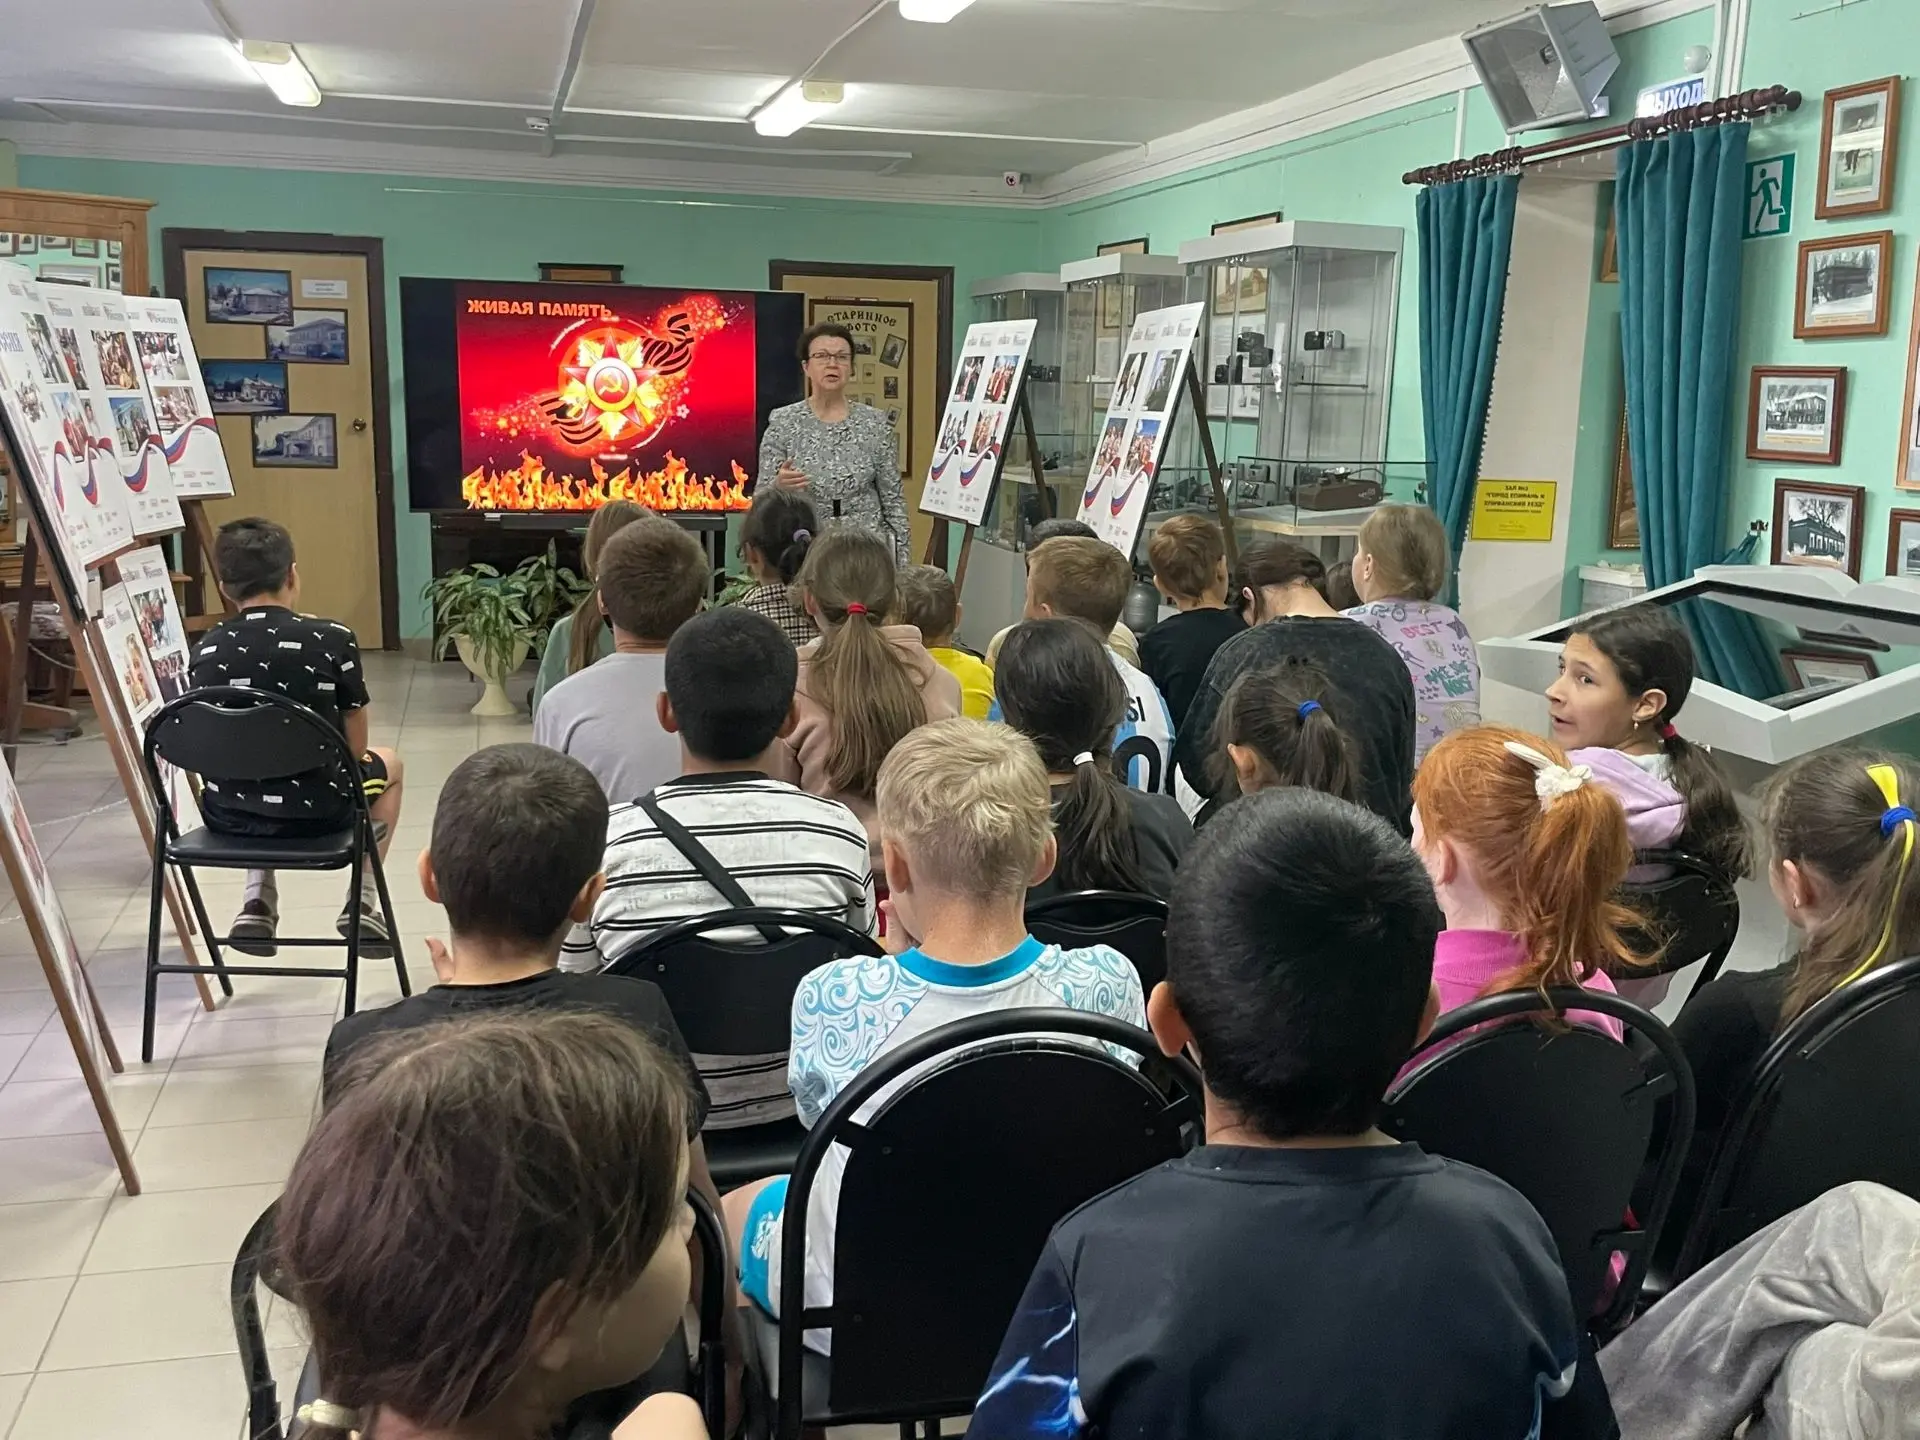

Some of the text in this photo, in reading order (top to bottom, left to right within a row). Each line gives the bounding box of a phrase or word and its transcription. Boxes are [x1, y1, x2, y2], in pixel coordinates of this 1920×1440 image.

[467, 299, 613, 317] ЖИВАЯ ПАМЯТЬ
[1400, 620, 1443, 638] BEST
